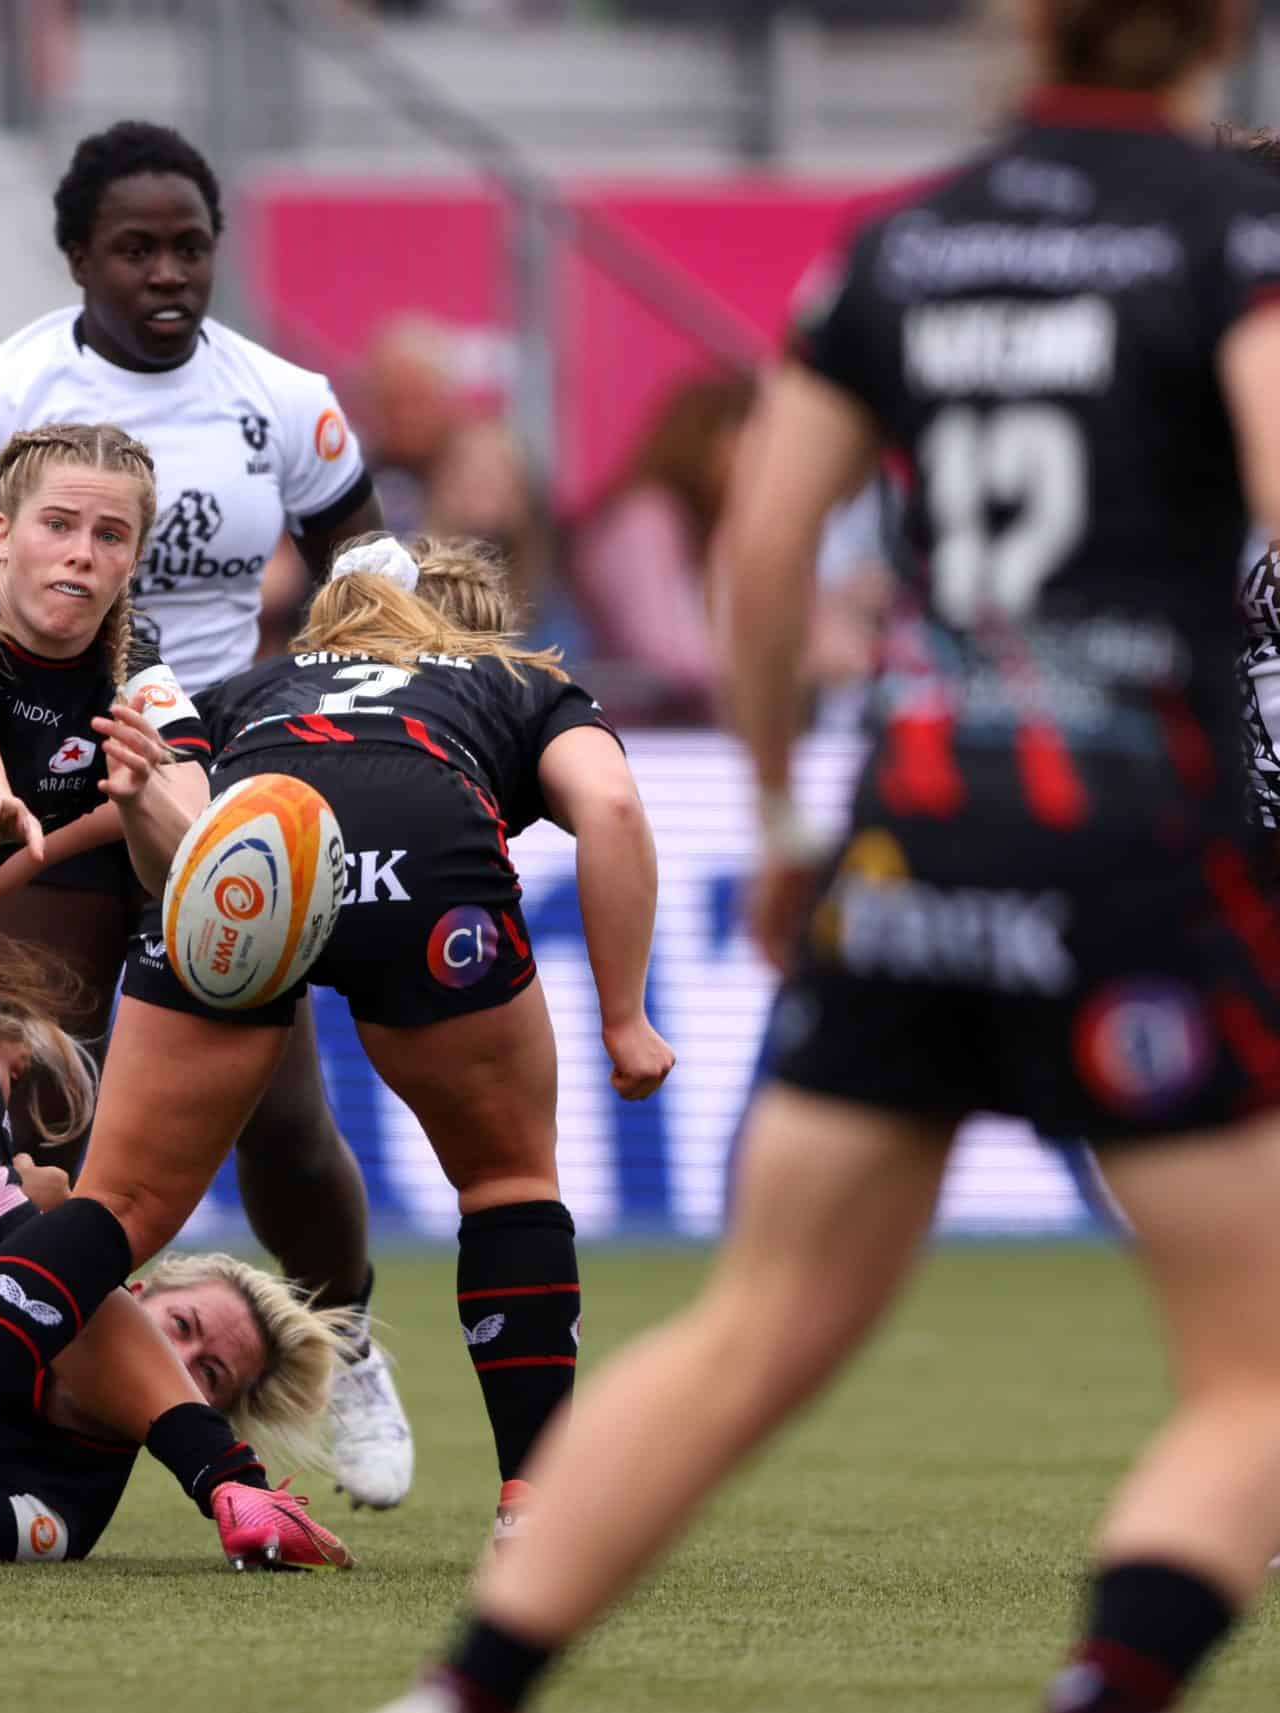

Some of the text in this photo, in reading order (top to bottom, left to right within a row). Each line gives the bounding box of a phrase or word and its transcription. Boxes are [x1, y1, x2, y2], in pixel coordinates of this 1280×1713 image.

[314, 663, 418, 716] 2
[209, 925, 239, 976] PWR
[442, 923, 484, 968] CI
